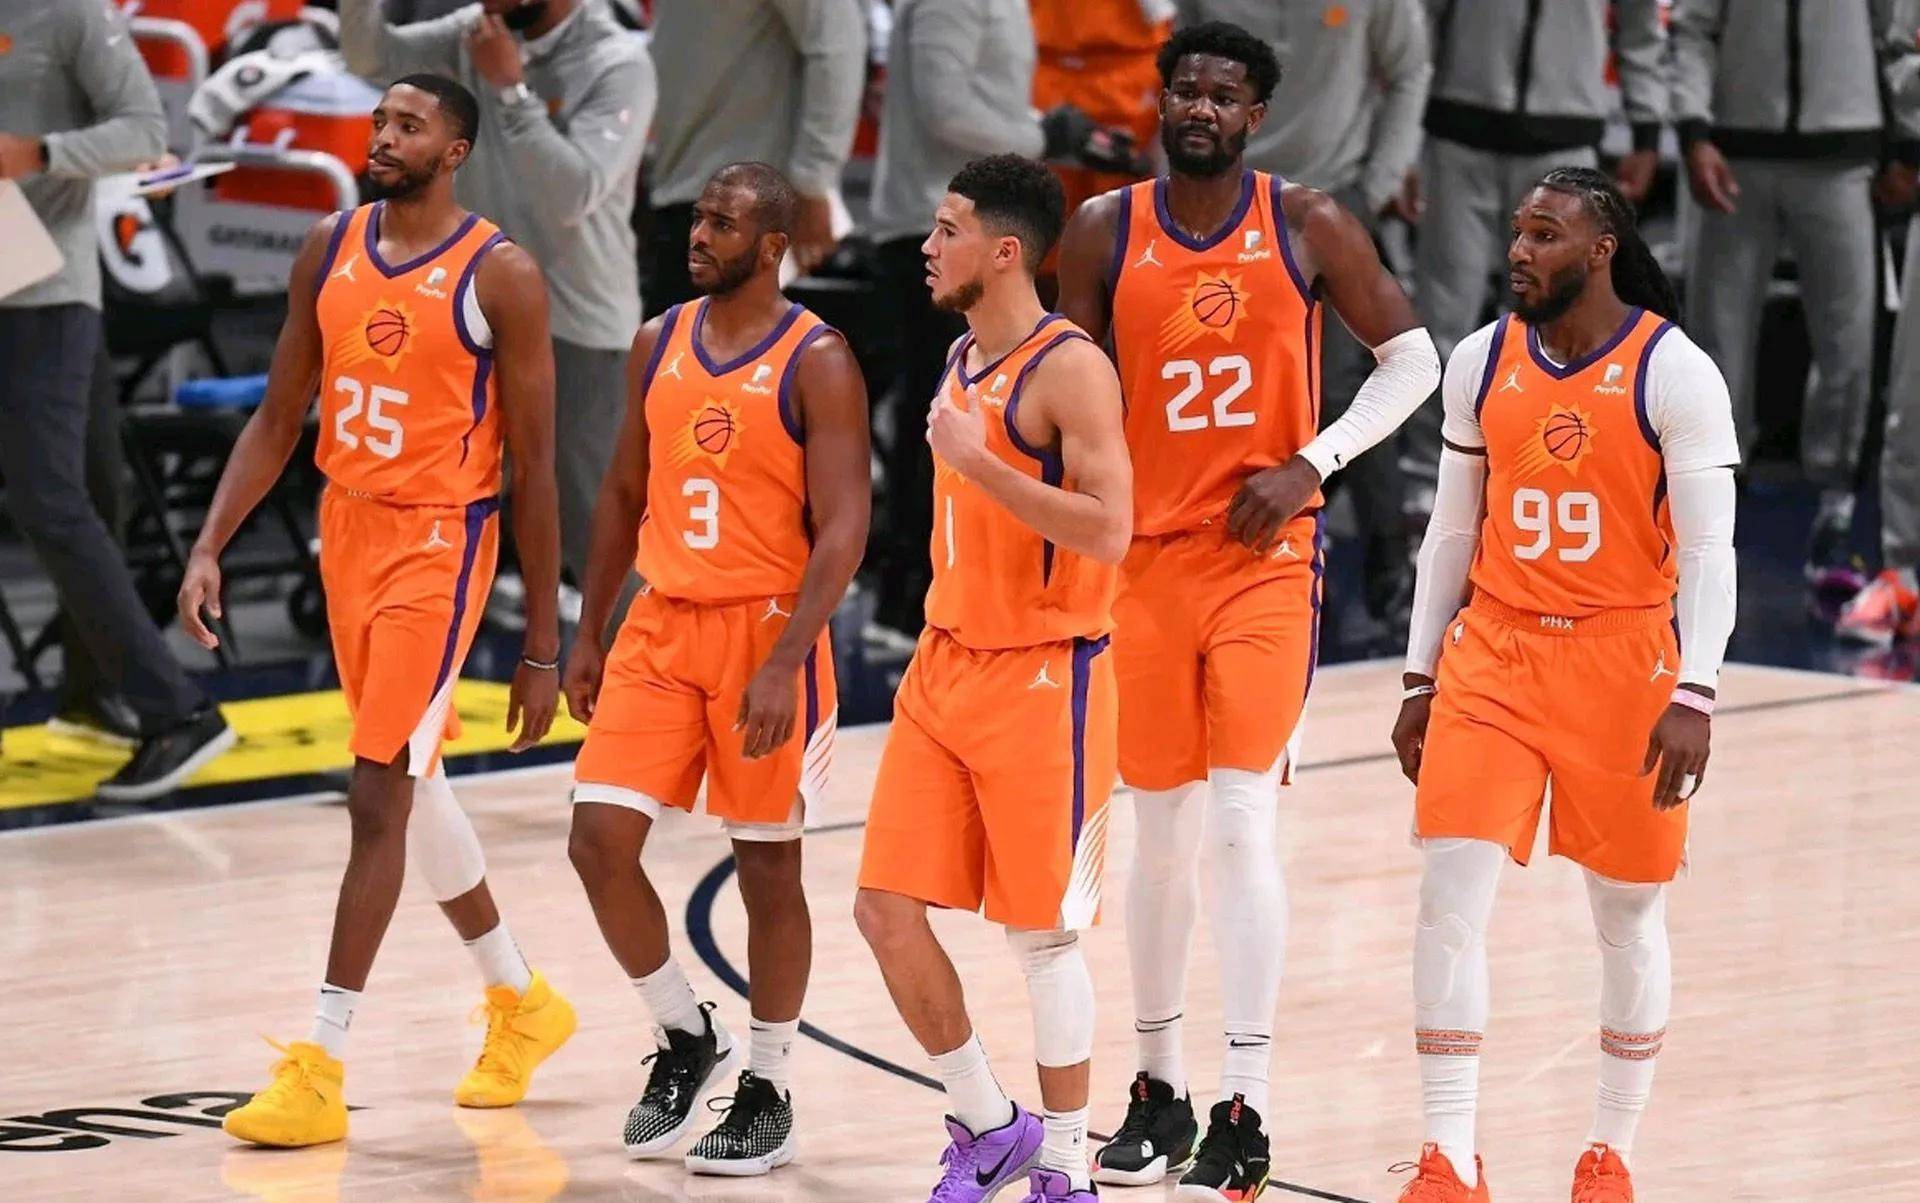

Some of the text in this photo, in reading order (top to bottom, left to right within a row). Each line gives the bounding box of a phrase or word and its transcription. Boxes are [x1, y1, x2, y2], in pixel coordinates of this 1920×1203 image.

[1237, 248, 1272, 264] PayPal
[334, 375, 409, 460] 25
[1161, 354, 1257, 432] 22
[1593, 384, 1627, 396] PayPal
[681, 477, 720, 550] 3
[1512, 487, 1601, 562] 99
[1540, 615, 1574, 630] PHX
